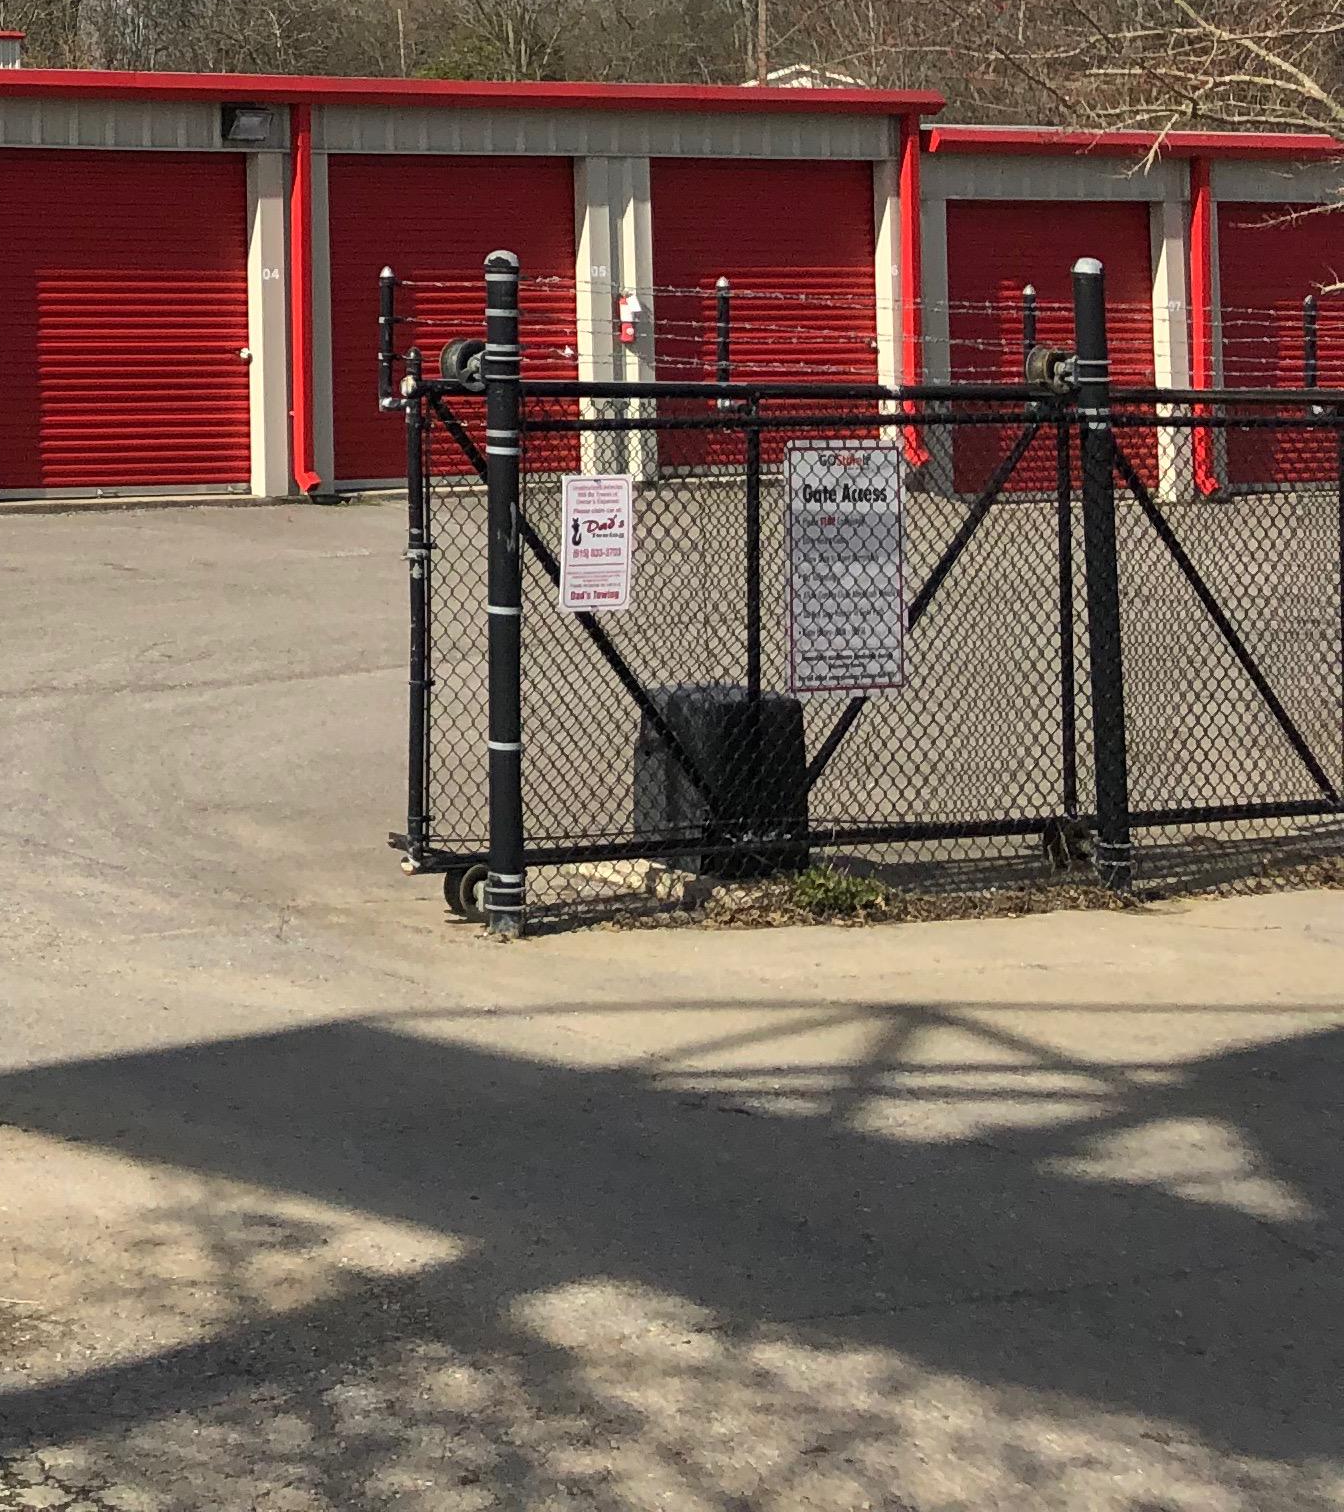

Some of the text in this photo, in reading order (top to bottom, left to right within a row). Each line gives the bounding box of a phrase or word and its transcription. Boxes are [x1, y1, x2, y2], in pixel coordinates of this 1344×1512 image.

[263, 268, 280, 280] 04
[591, 265, 607, 277] 05
[802, 483, 888, 503] Gate Access
[582, 514, 625, 533] Dad's
[570, 590, 620, 600] Dad's Towing
